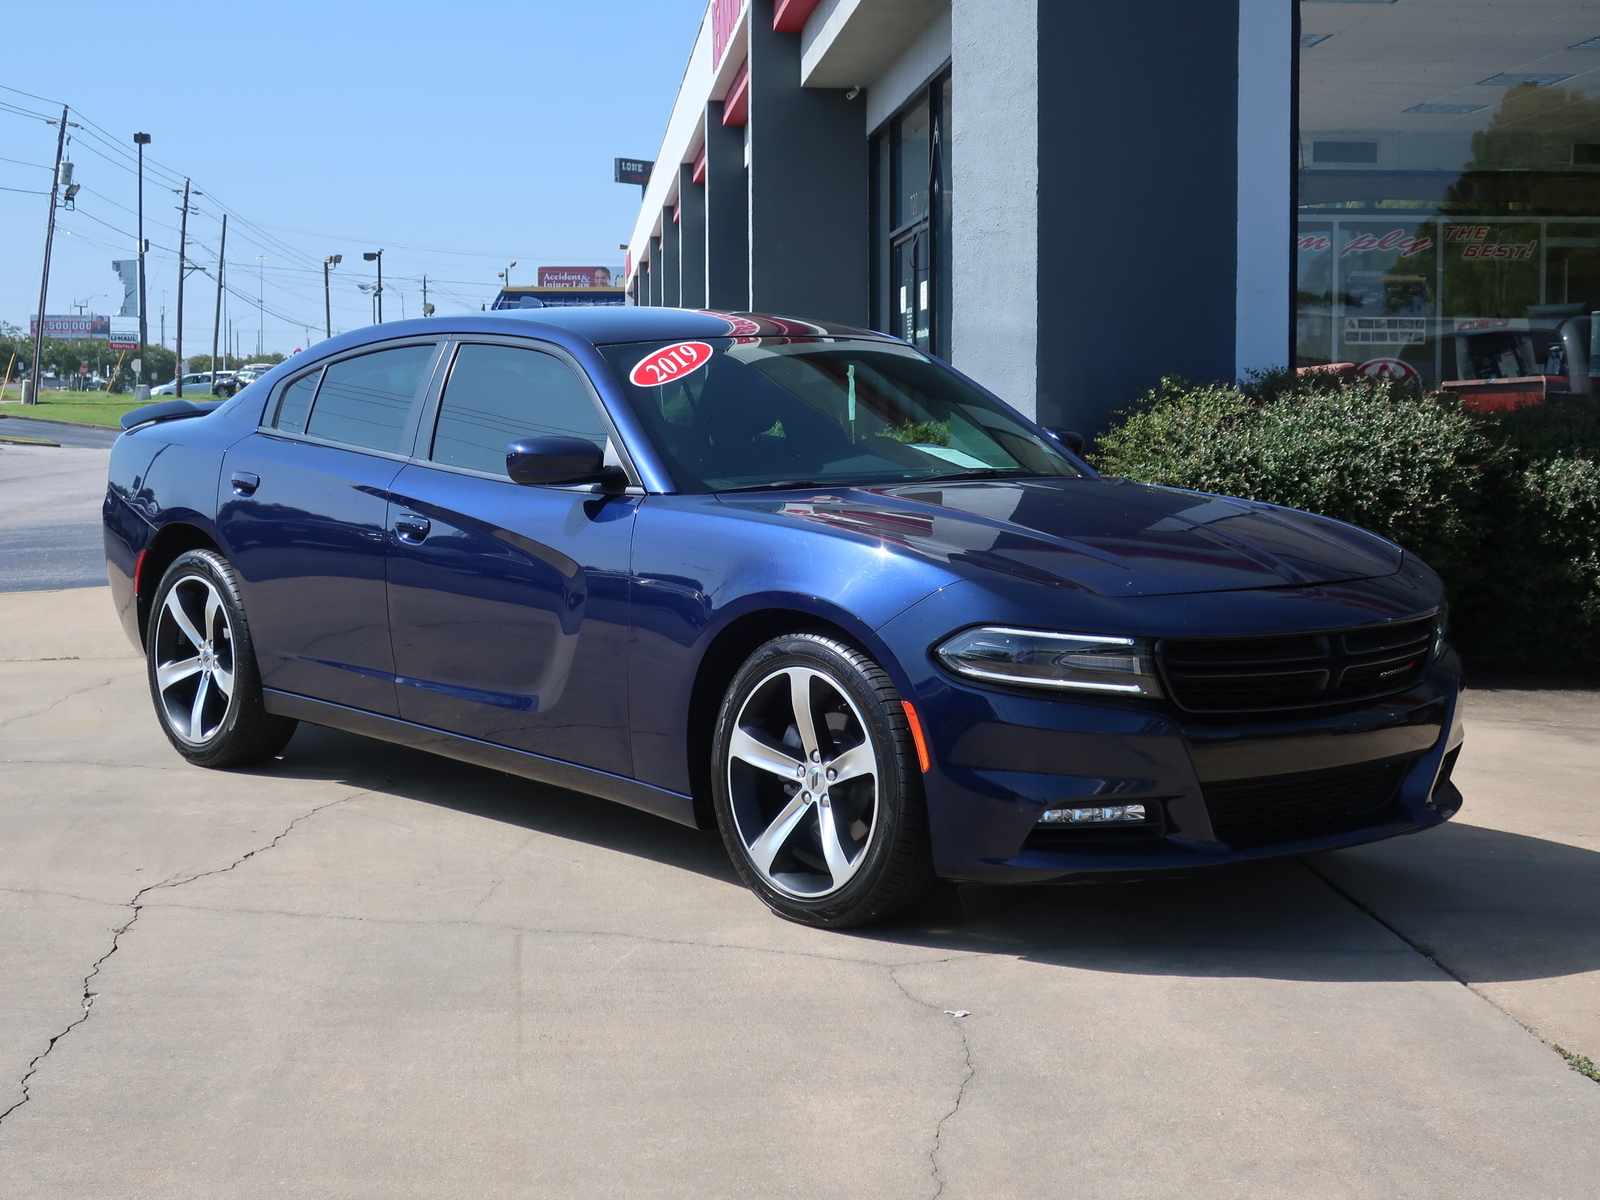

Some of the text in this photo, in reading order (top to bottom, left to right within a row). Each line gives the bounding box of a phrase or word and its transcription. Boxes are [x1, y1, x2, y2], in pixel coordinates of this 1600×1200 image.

[621, 161, 643, 173] LONE
[1444, 225, 1491, 240] THE
[1340, 229, 1434, 257] ply
[1462, 240, 1538, 258] BEST!
[543, 272, 591, 283] Accident &
[33, 321, 92, 331] $,500000
[645, 345, 698, 383] 2019
